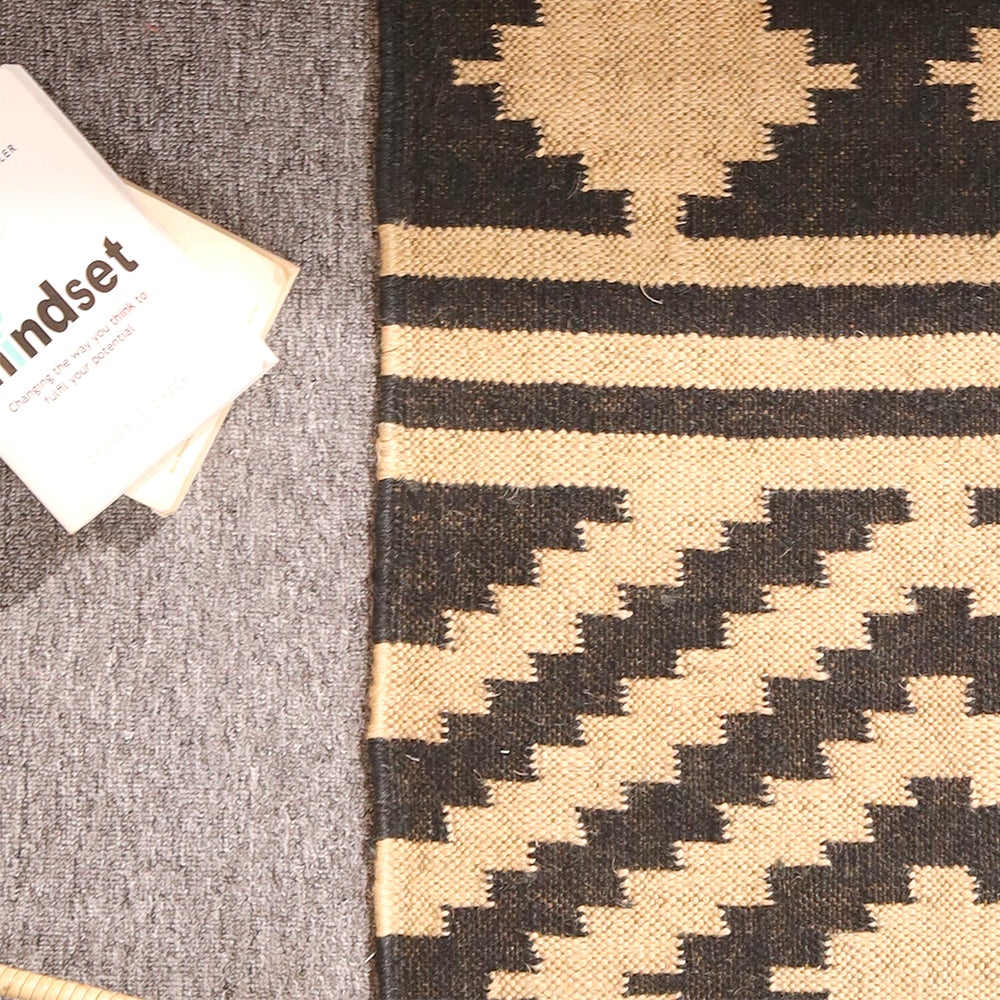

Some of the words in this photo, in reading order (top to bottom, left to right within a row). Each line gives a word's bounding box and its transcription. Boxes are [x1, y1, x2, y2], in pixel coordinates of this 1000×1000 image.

[8, 373, 55, 413] Changing
[52, 358, 71, 376] the
[71, 340, 92, 360] way
[91, 324, 111, 344] you
[109, 302, 136, 326] think
[135, 291, 148, 304] to
[69, 362, 91, 386] your
[91, 324, 136, 367] potential
